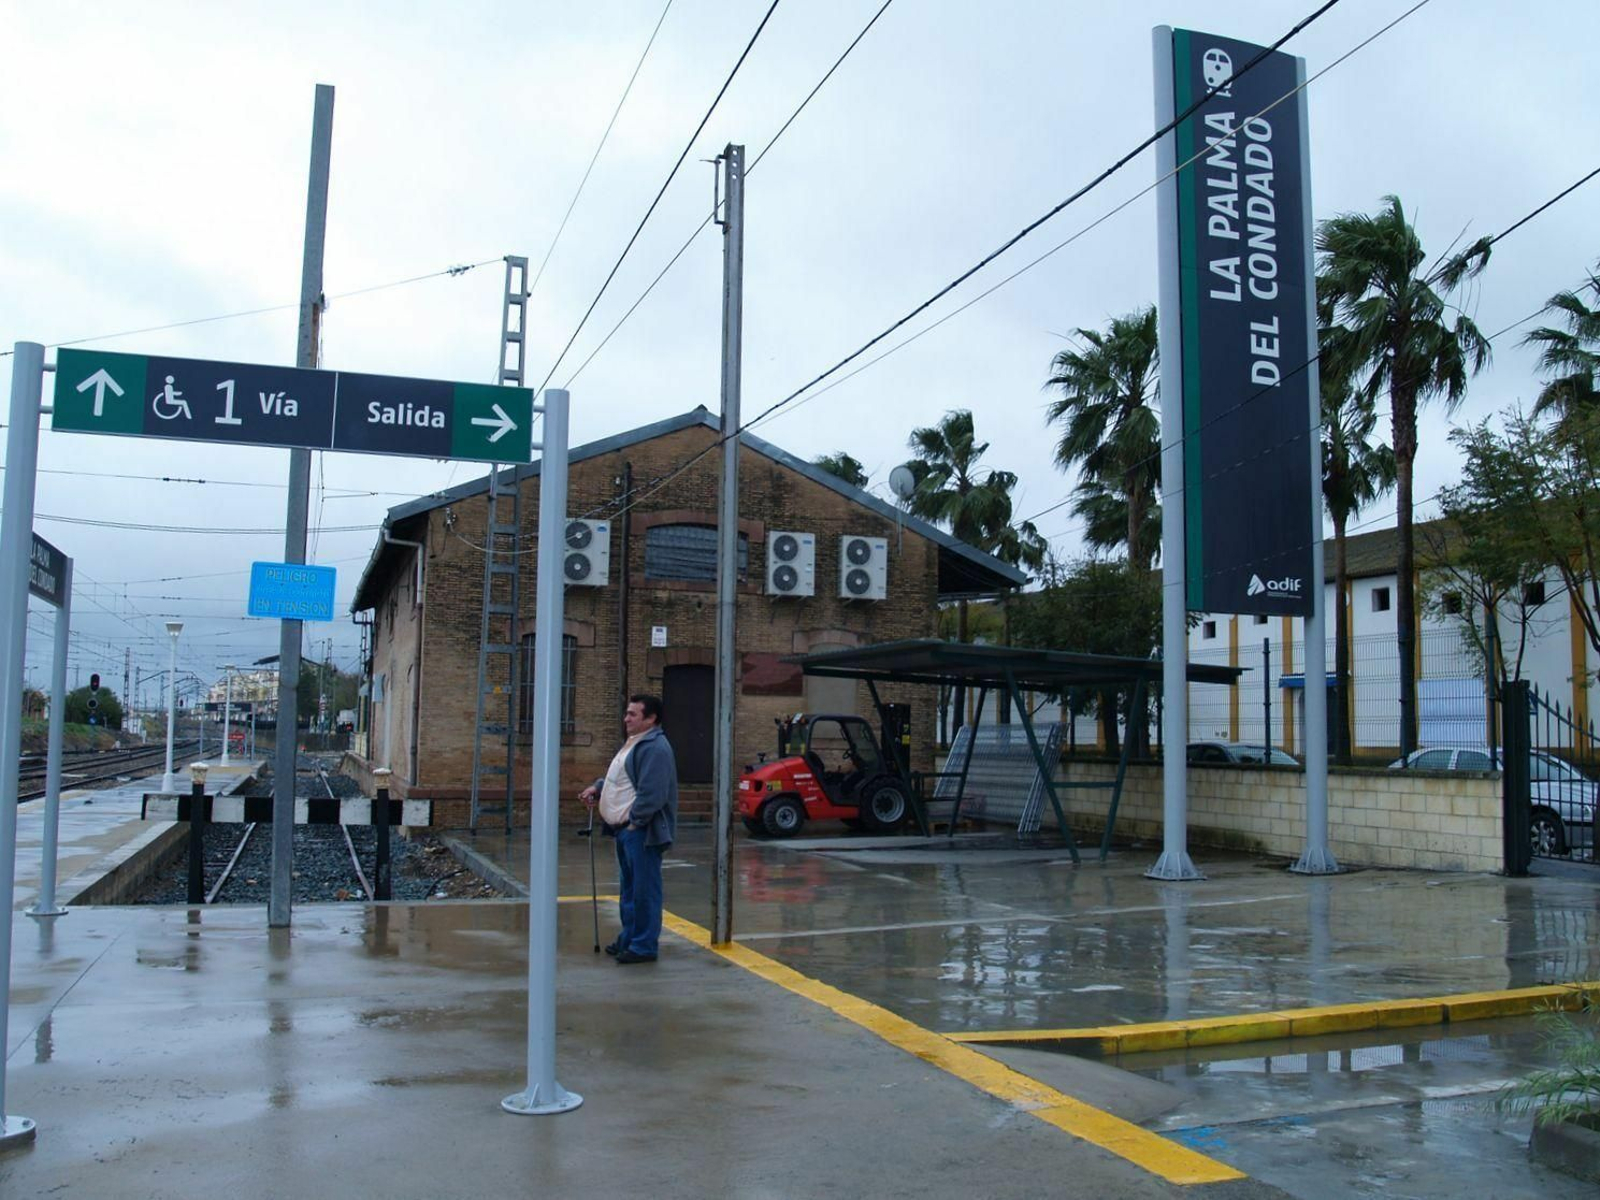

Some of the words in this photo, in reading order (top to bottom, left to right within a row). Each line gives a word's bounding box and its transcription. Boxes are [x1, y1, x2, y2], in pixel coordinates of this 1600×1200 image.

[1205, 111, 1240, 241] PALMA
[1244, 116, 1279, 301] CONDADO
[1210, 257, 1242, 302] LA
[1250, 316, 1281, 388] DEL
[214, 379, 243, 426] 1
[259, 391, 299, 417] Vía
[367, 401, 446, 429] Salida
[267, 568, 318, 583] PELIGRO
[1266, 577, 1302, 591] adif
[256, 598, 272, 612] EN
